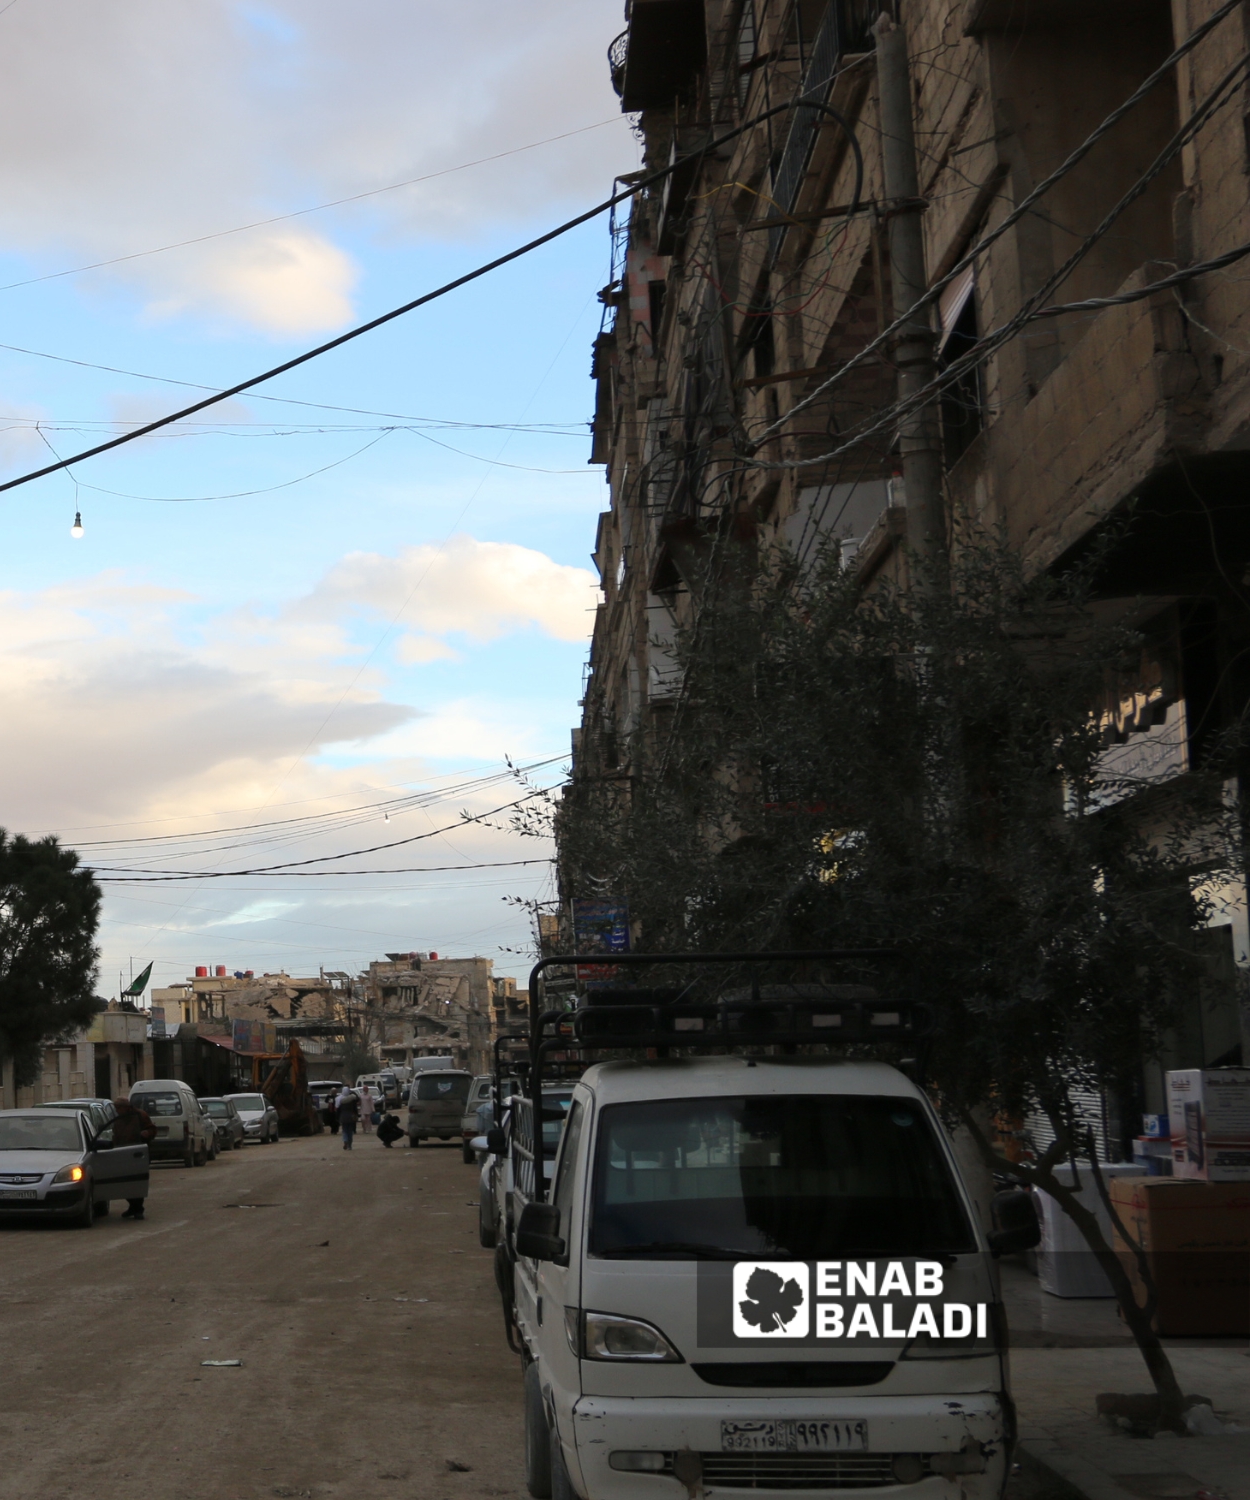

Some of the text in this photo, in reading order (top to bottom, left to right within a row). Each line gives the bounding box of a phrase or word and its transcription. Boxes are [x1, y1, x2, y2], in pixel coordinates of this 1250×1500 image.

[724, 1422, 867, 1450] دمشق ٩٩٢١١٩
[727, 1436, 775, 1447] 992119
